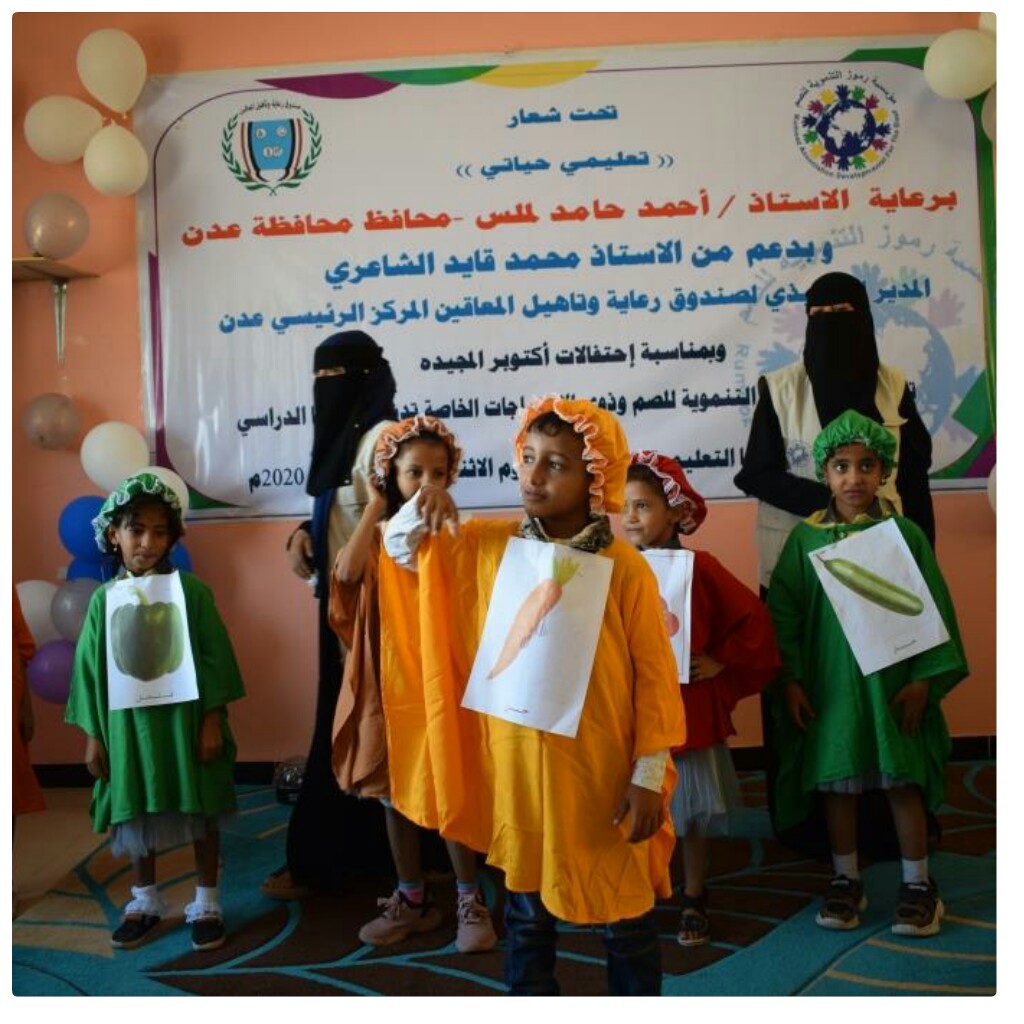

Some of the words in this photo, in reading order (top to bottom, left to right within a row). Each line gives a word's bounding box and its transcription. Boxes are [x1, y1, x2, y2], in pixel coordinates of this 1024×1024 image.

[507, 107, 561, 128] شعار
[569, 105, 618, 122] تحت
[481, 155, 550, 180] حياتي
[560, 151, 650, 176] تعليمي
[550, 198, 625, 222] حامد
[638, 189, 710, 217] أحمد
[749, 189, 849, 213] الاستاذ
[869, 187, 957, 214] برعاية
[252, 212, 353, 237] محافظة
[476, 203, 539, 229] لملس
[181, 221, 241, 246] عدن
[444, 250, 496, 278] قايد
[505, 248, 581, 274] محمد
[590, 238, 682, 267] الاستاذ
[691, 244, 733, 269] من
[746, 239, 833, 268] وبدعم
[324, 251, 434, 288] الشاعري
[607, 288, 661, 316] رعاية
[668, 284, 757, 316] لصندوق
[873, 278, 931, 304] المدير
[271, 303, 364, 335] الرئيسي
[371, 298, 429, 326] المركز
[435, 295, 514, 325] المعاقين
[523, 290, 600, 322] وتاهيل
[219, 311, 264, 333] عدن
[421, 350, 484, 374] المجيده
[490, 342, 549, 373] أكتوبر
[556, 343, 635, 368] إحتفالات
[642, 341, 727, 364] وبمناسبة
[424, 398, 479, 419] الخاصة
[632, 389, 676, 416] للصم
[682, 387, 756, 413] التنموية
[237, 405, 307, 436] الدراسي
[249, 467, 305, 493] 2020م
